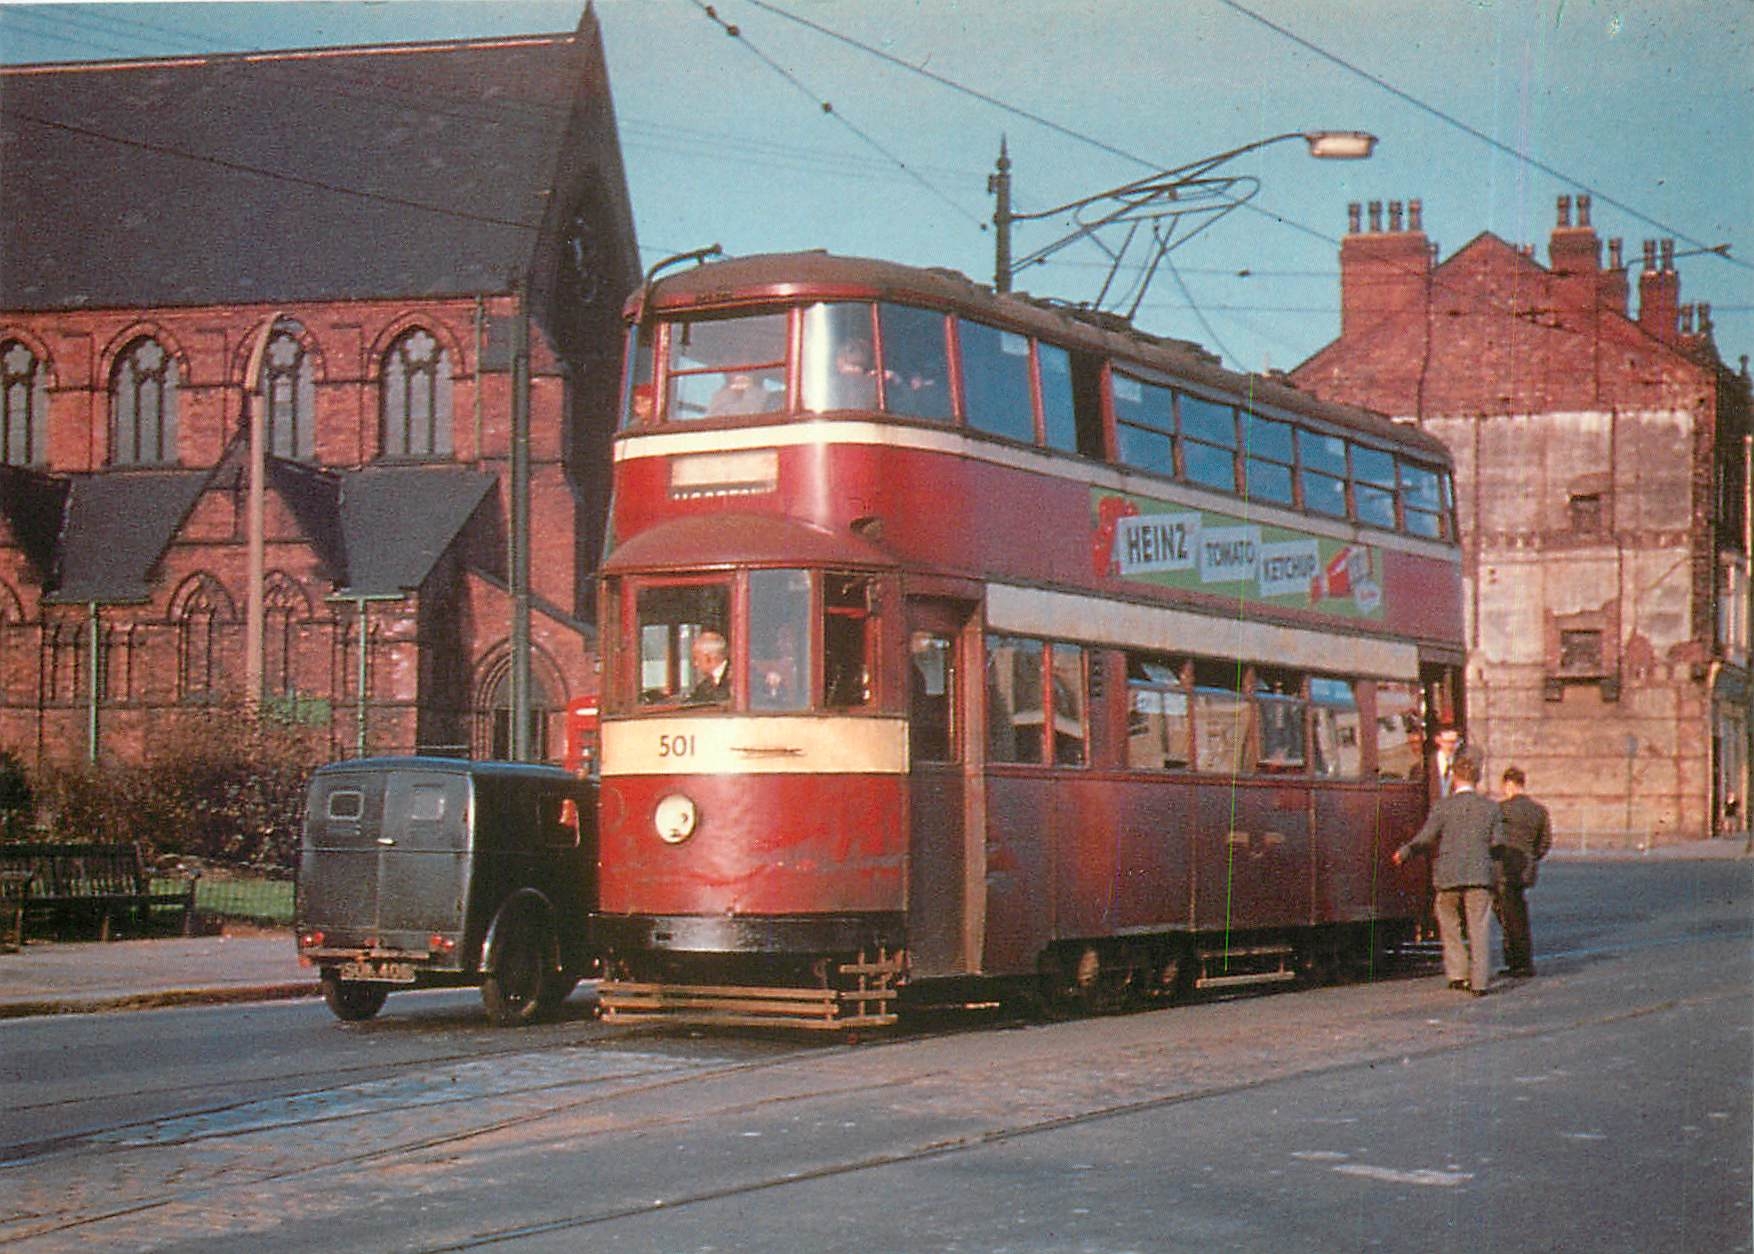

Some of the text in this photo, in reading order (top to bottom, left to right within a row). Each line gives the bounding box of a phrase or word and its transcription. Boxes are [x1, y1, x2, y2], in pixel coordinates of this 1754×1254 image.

[1126, 523, 1317, 581] HEINZ TOMATO KETCHUP
[659, 734, 695, 757] 501
